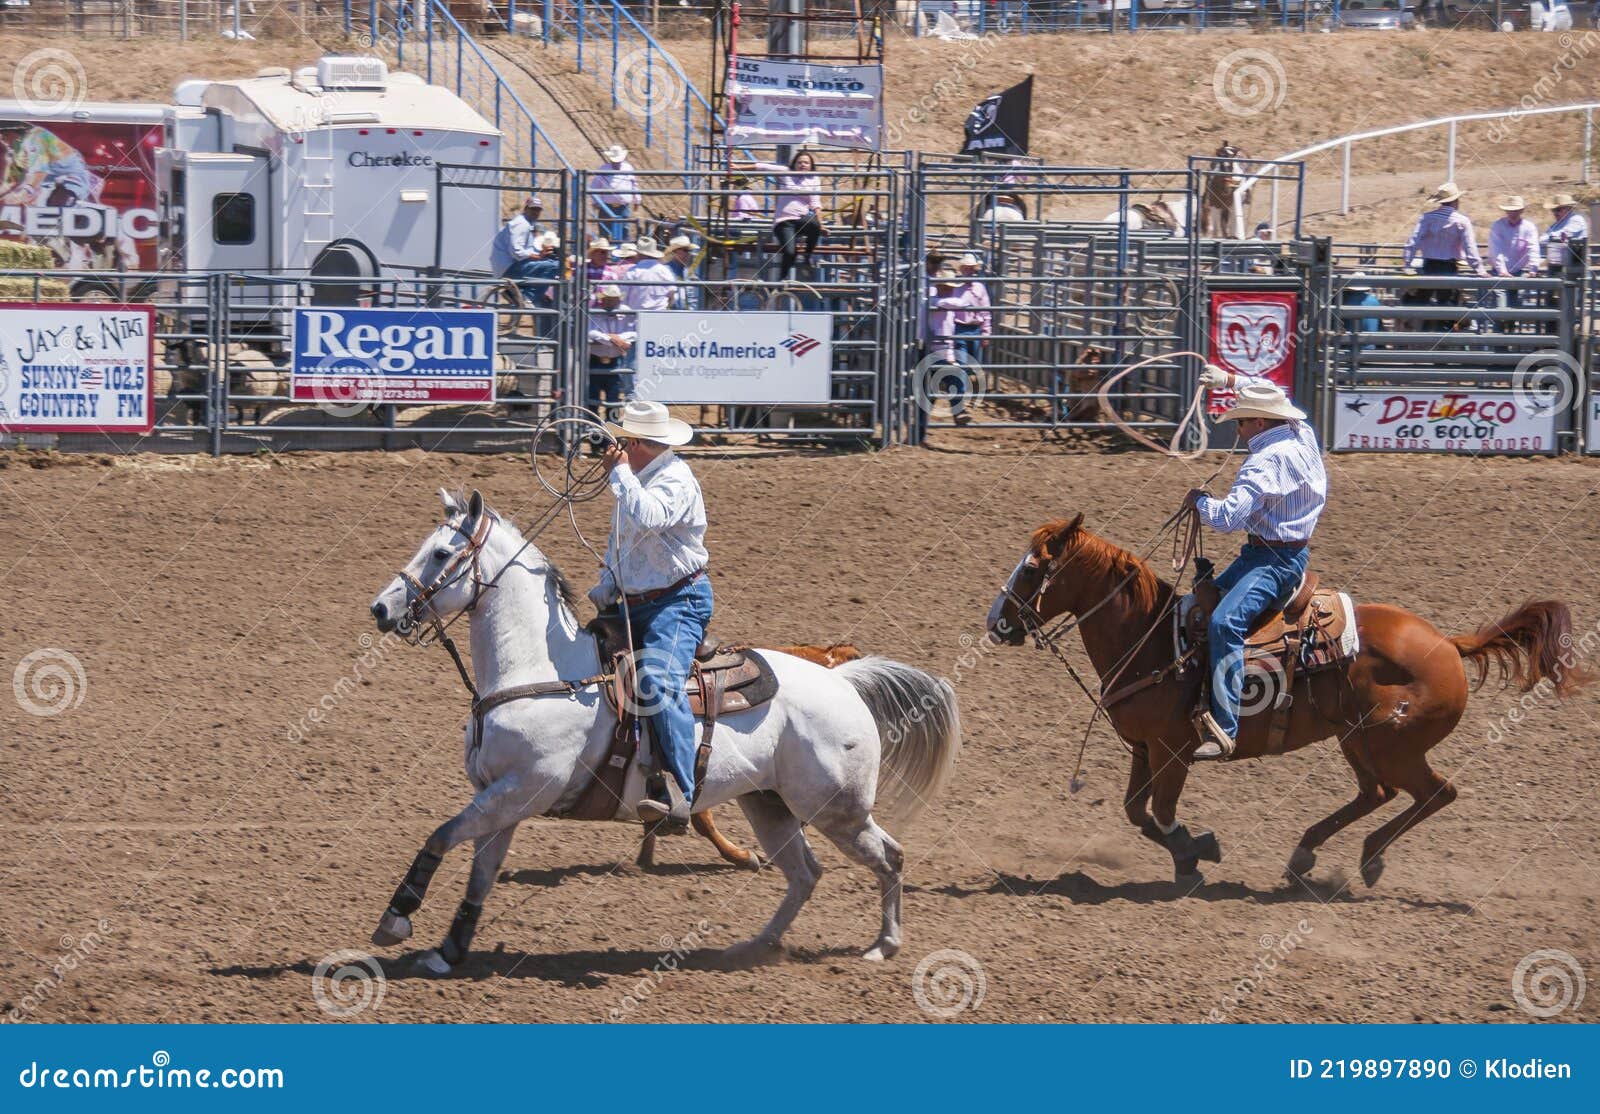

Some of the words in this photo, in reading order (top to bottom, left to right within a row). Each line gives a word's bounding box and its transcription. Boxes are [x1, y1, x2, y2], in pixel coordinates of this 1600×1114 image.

[786, 79, 865, 92] RODEO
[348, 151, 433, 168] Cherokee
[16, 326, 67, 363] JAY
[75, 325, 94, 350] &
[301, 311, 489, 372] Regan
[645, 341, 686, 358] Bank
[689, 341, 706, 358] of
[708, 341, 776, 359] America
[21, 365, 80, 390] SUNNY
[19, 393, 99, 418] COUNTRY
[117, 394, 143, 418] FM
[1395, 424, 1424, 439] GO
[1435, 424, 1495, 439] BOLD!
[1349, 434, 1430, 450] FRIENDS
[1444, 440, 1467, 450] OF
[1481, 435, 1543, 450] RODEO
